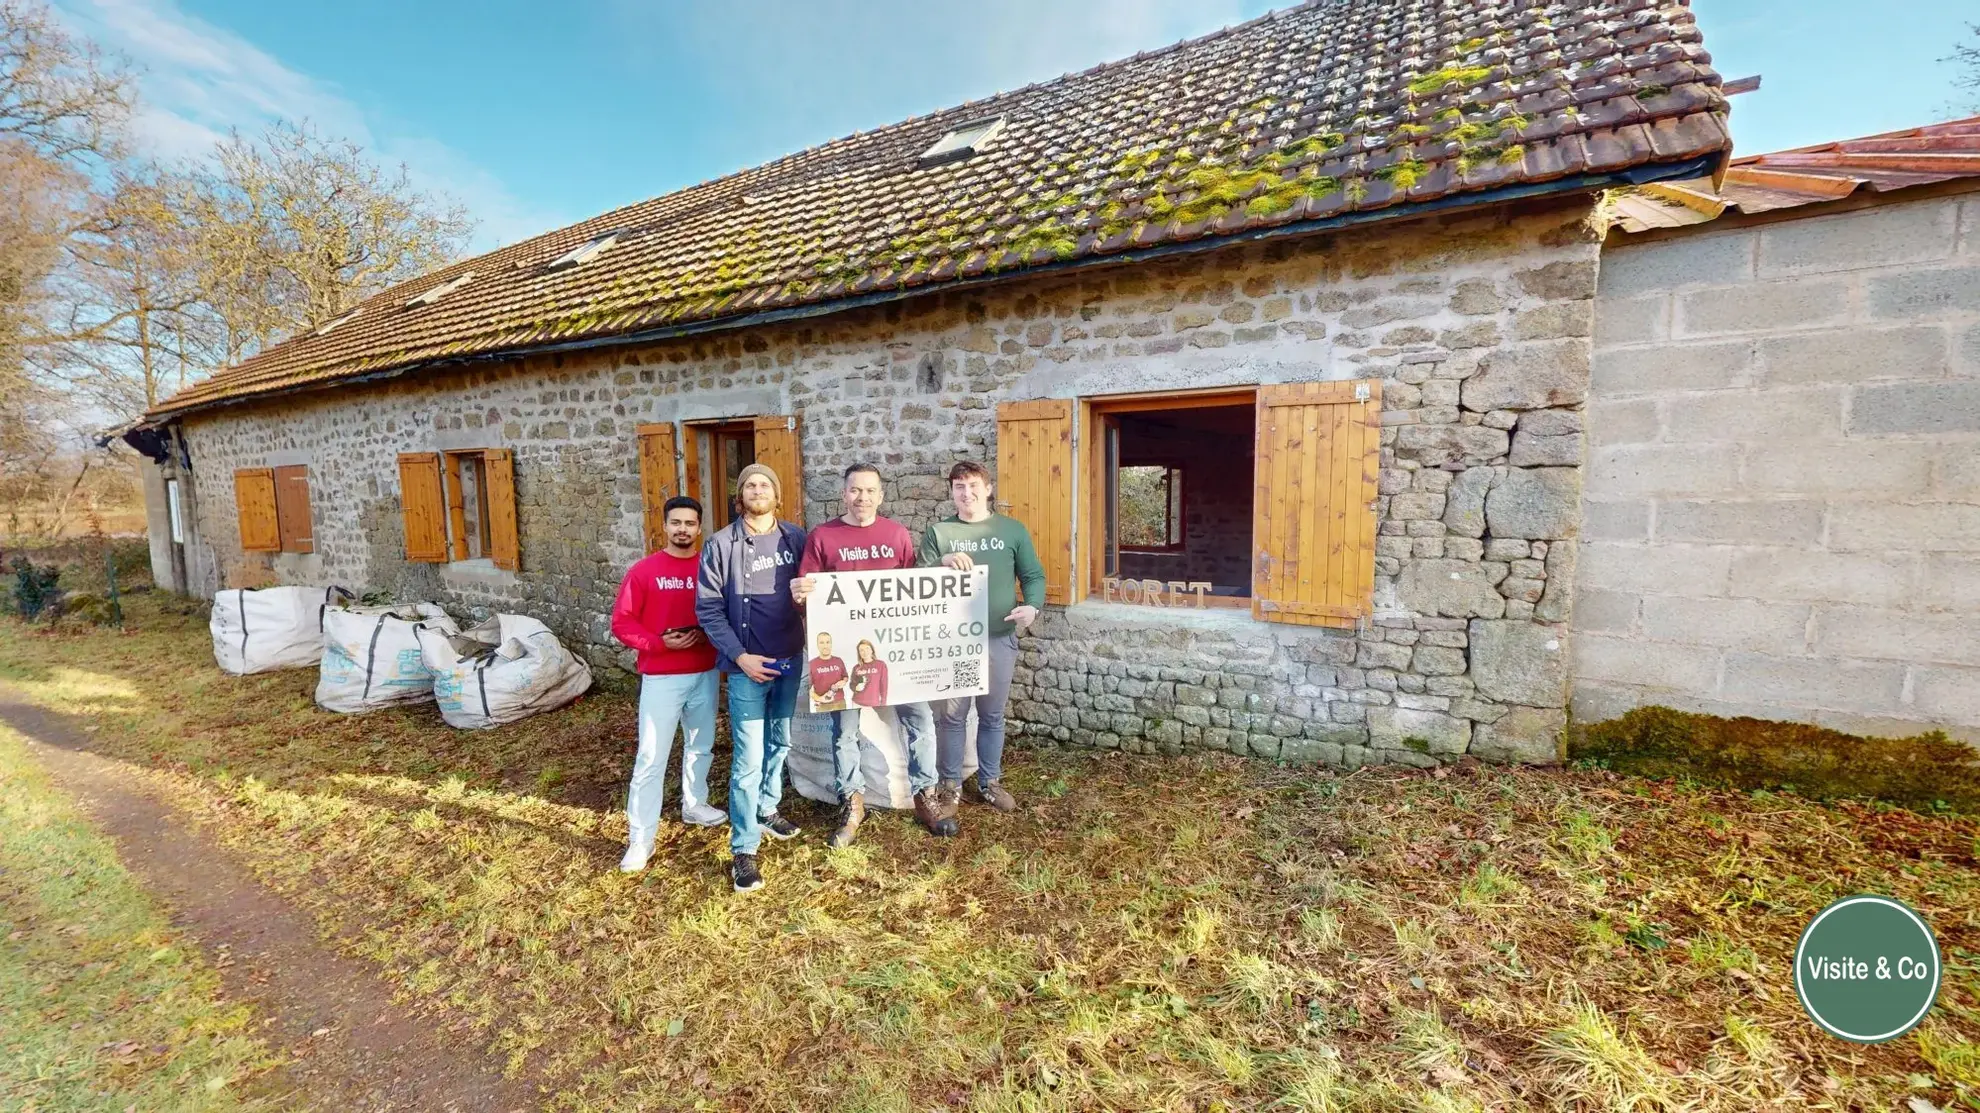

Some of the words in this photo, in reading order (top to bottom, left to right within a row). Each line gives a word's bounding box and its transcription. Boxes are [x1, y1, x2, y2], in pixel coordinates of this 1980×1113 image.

[838, 547, 869, 562] Visite
[871, 544, 880, 559] &
[881, 544, 895, 558] Co
[949, 539, 977, 552] Visite
[980, 538, 988, 550] &
[990, 537, 1005, 550] Co
[751, 554, 774, 572] isite
[775, 551, 785, 566] &
[655, 576, 684, 590] Visite
[686, 576, 694, 589] &
[825, 574, 846, 606] À
[856, 573, 972, 603] VENDRE
[1102, 577, 1212, 609] FORET
[850, 608, 866, 620] EN
[871, 601, 948, 619] EXCLUSIVITÉ
[874, 624, 931, 644] VISITE
[938, 623, 951, 640] &
[958, 621, 984, 637] CO
[888, 650, 905, 662] 02
[910, 648, 923, 661] 61
[928, 646, 943, 660] 53
[947, 645, 962, 658] 63
[966, 643, 983, 656] 00
